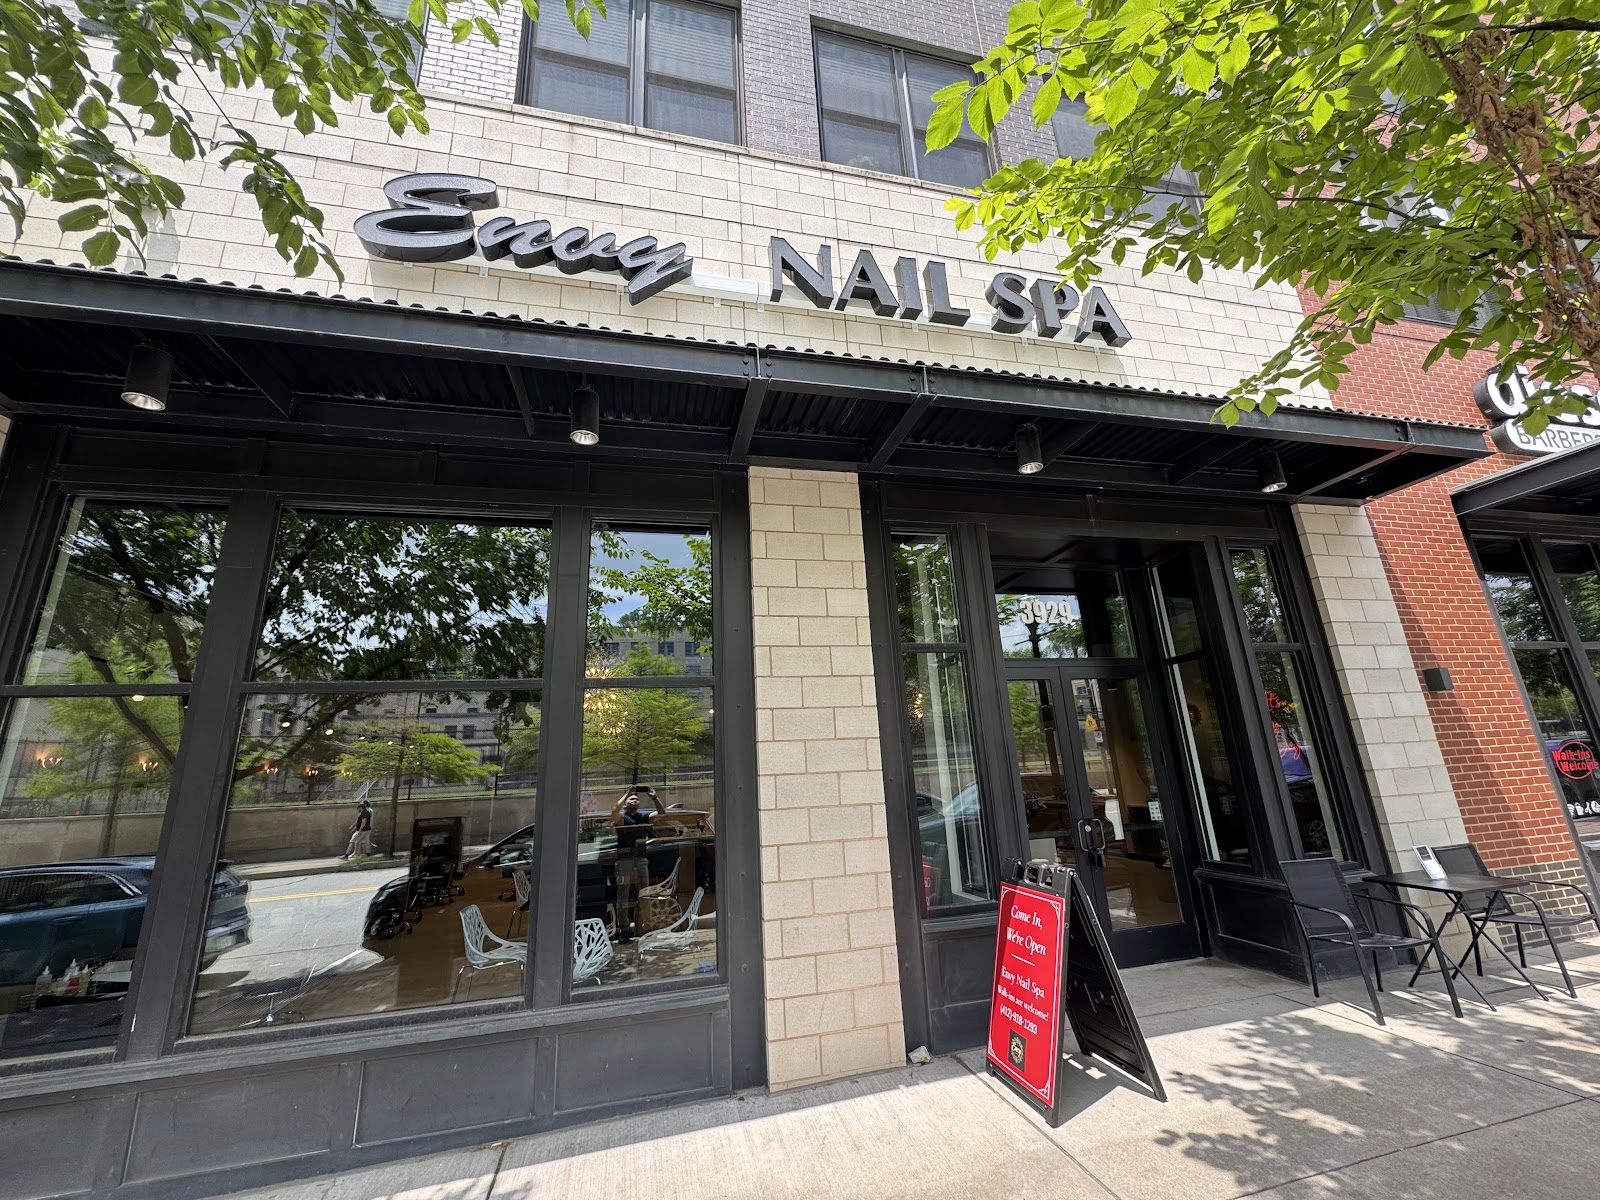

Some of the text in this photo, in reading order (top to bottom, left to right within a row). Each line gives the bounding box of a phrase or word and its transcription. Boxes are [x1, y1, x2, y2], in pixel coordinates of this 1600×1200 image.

[353, 172, 694, 306] Envy
[767, 235, 1132, 348] NAIL SPA
[1019, 600, 1073, 625] 3929
[1560, 760, 1599, 772] Welcome
[1011, 905, 1043, 930] Come In,
[1006, 926, 1047, 956] We're Open
[1001, 965, 1045, 1000] Envy Nail Spa
[1023, 1002, 1049, 1022] welcome!
